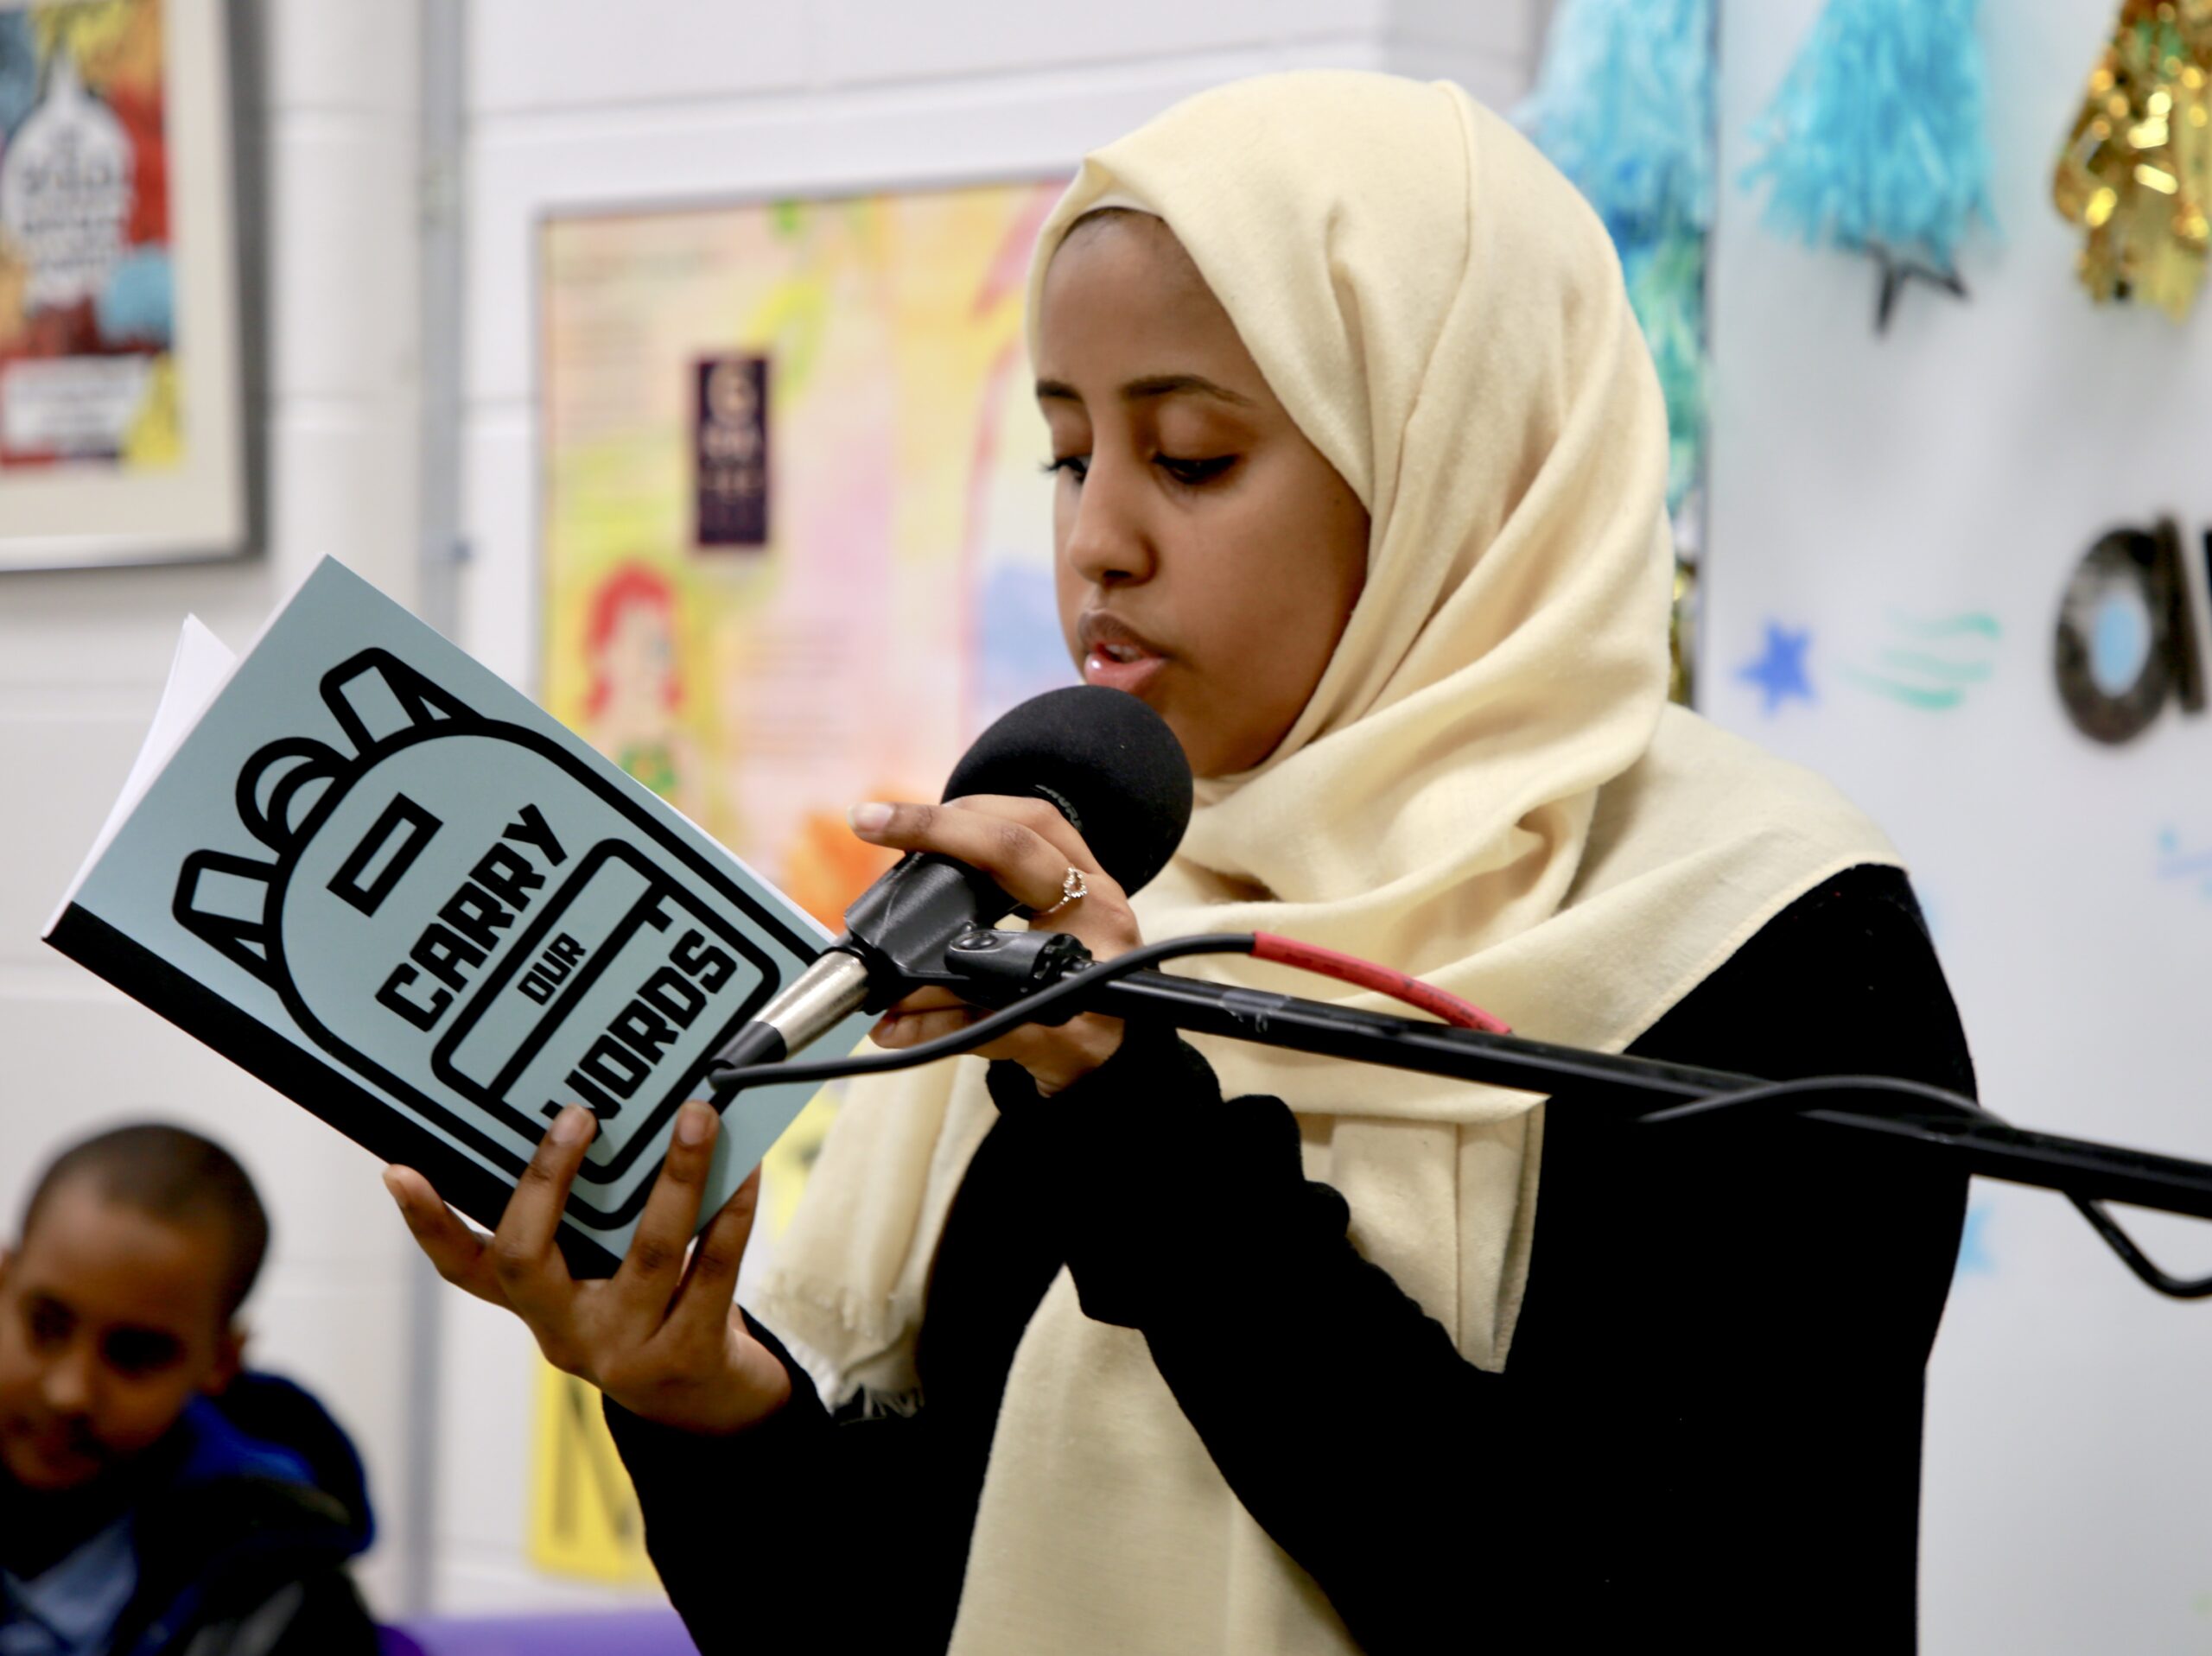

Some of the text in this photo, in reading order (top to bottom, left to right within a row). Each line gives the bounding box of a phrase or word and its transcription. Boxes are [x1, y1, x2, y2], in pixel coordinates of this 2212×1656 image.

[375, 803, 568, 1032] CARRY
[517, 932, 586, 1006] OUR
[539, 928, 738, 1144] WORDS
